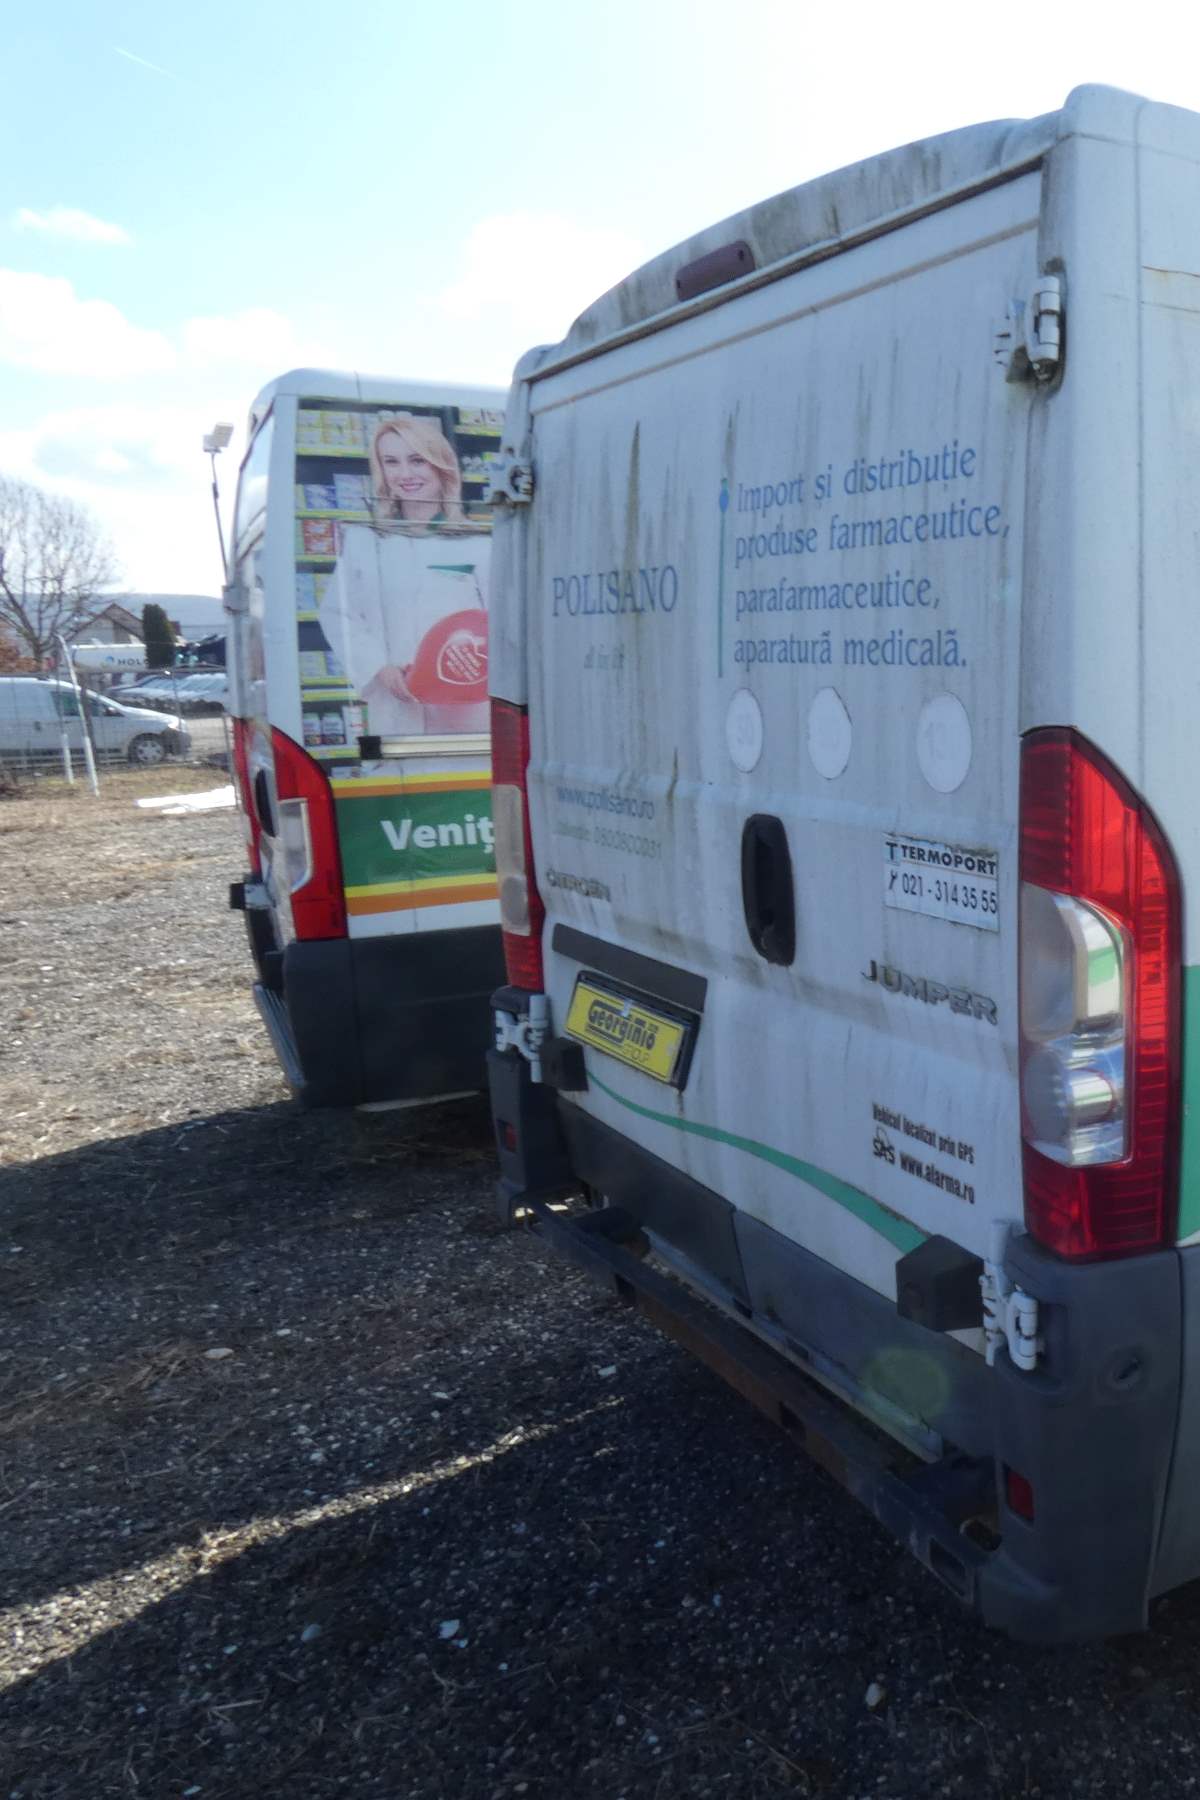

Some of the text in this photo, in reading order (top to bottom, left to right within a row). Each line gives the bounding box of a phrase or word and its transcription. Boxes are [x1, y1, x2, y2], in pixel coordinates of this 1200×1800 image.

[737, 475, 803, 520] Import
[734, 502, 1010, 568] produse farmaceutice,
[551, 564, 679, 617] POLISANO
[735, 570, 940, 621] parafarmaceutice,
[901, 844, 997, 876] TERMOPORT
[902, 872, 924, 897] 021
[859, 959, 998, 1027] JUMPER
[957, 1140, 975, 1165] GPS
